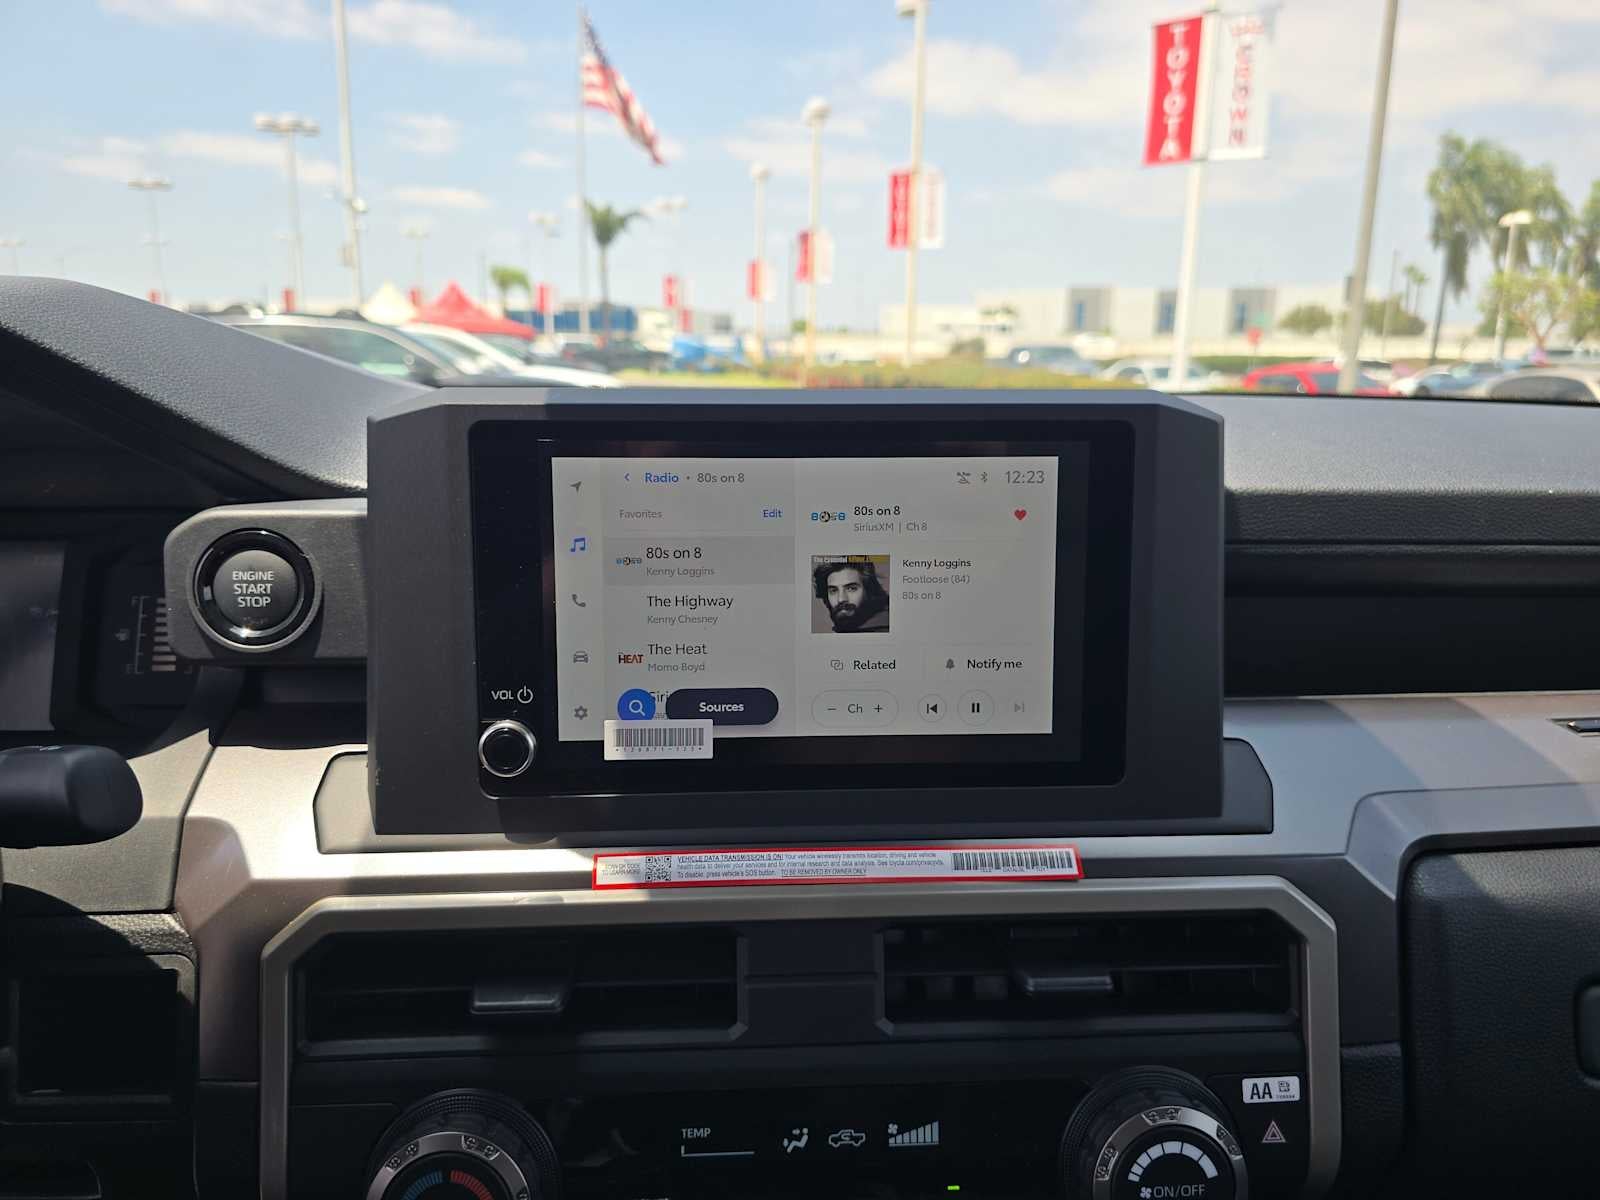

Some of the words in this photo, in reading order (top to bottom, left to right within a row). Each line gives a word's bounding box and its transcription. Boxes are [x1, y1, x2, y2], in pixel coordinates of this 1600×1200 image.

[1159, 23, 1190, 160] TOYOTA
[645, 472, 679, 483] Radio
[697, 473, 717, 483] 80s
[721, 475, 735, 483] on
[737, 473, 745, 483] 8
[1005, 470, 1045, 484] 12:23
[619, 509, 663, 519] Favorites
[763, 509, 782, 518] Edit
[854, 506, 874, 516] 80s
[877, 508, 891, 516] on
[893, 506, 901, 516] 8
[854, 522, 894, 532] SiriusXM
[906, 522, 920, 532] Ch
[921, 522, 928, 532] 8
[646, 547, 669, 559] 80s
[673, 550, 690, 559] on
[694, 547, 702, 559] 8
[902, 558, 932, 570] Kenny
[934, 558, 972, 570] Loggins
[232, 571, 274, 581] ENGINE
[646, 566, 675, 577] Kenny
[677, 566, 715, 577] Loggins
[902, 575, 950, 584] Footloose
[951, 574, 970, 584] (84)
[233, 583, 273, 594] START
[902, 591, 919, 600] 80s
[935, 591, 942, 600] 8
[238, 597, 271, 608] STOP
[647, 595, 671, 607] The
[675, 595, 734, 610] Highway
[647, 615, 675, 626] Kenny
[678, 614, 719, 626] Chesney
[648, 643, 671, 655] The
[675, 643, 707, 655] Heat
[618, 654, 644, 664] HEAT
[853, 659, 896, 670] Related
[648, 662, 678, 672] Momo
[681, 662, 705, 674] Boyd
[967, 659, 1002, 671] Notify
[1004, 661, 1023, 669] me
[491, 690, 514, 700] VOL
[699, 702, 745, 713] Sources
[848, 703, 863, 713] Ch
[678, 855, 702, 863] VEHICLE
[1250, 1082, 1273, 1100] AA
[681, 1128, 711, 1139] TEMP
[1153, 1183, 1206, 1198] ON/OFF
